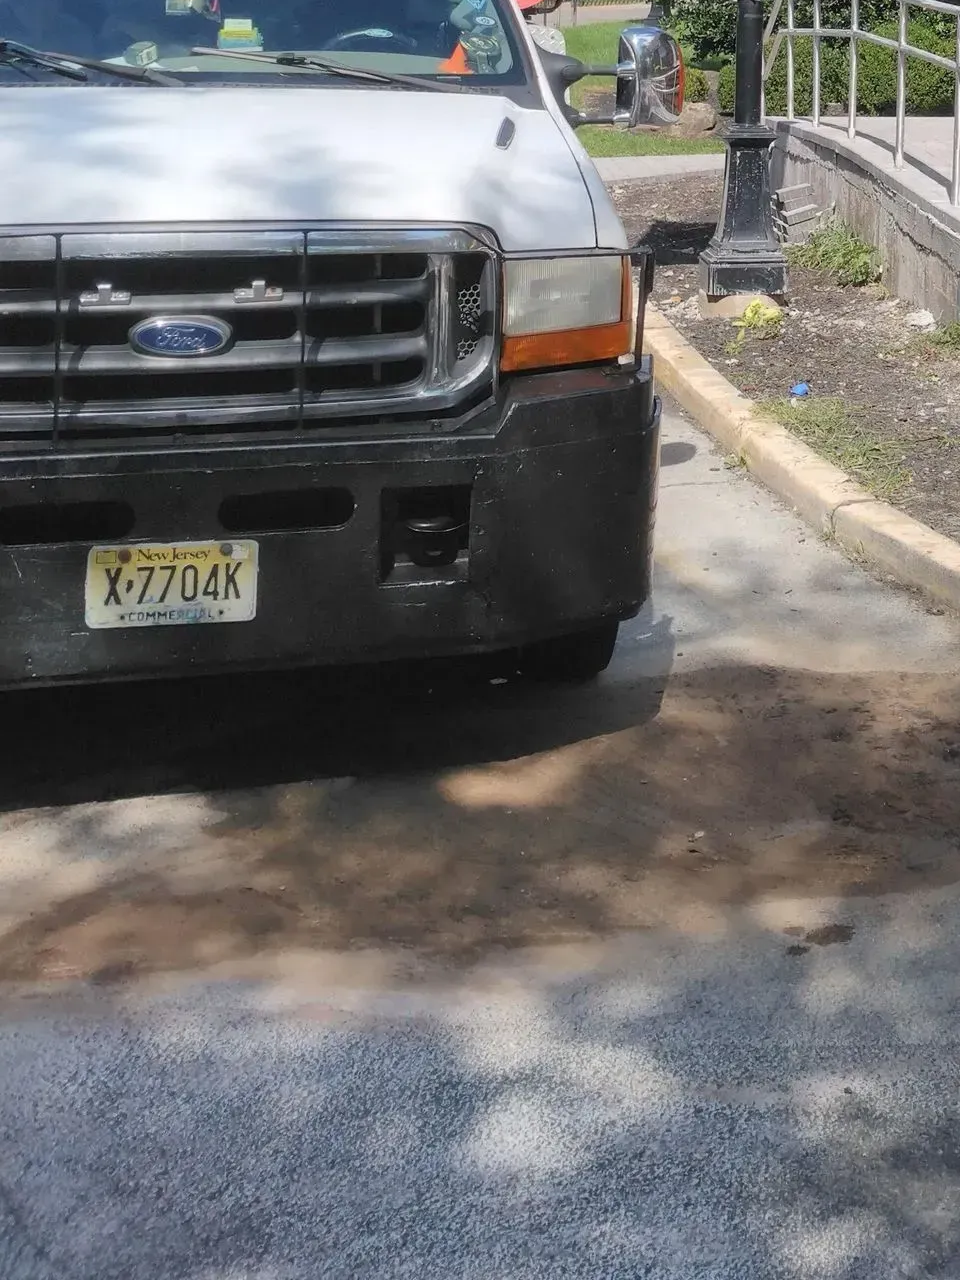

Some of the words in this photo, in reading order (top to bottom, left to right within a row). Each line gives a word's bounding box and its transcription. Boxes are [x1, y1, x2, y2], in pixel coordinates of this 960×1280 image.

[156, 326, 207, 349] Ford
[137, 549, 170, 561] New
[171, 548, 210, 563] Jersey
